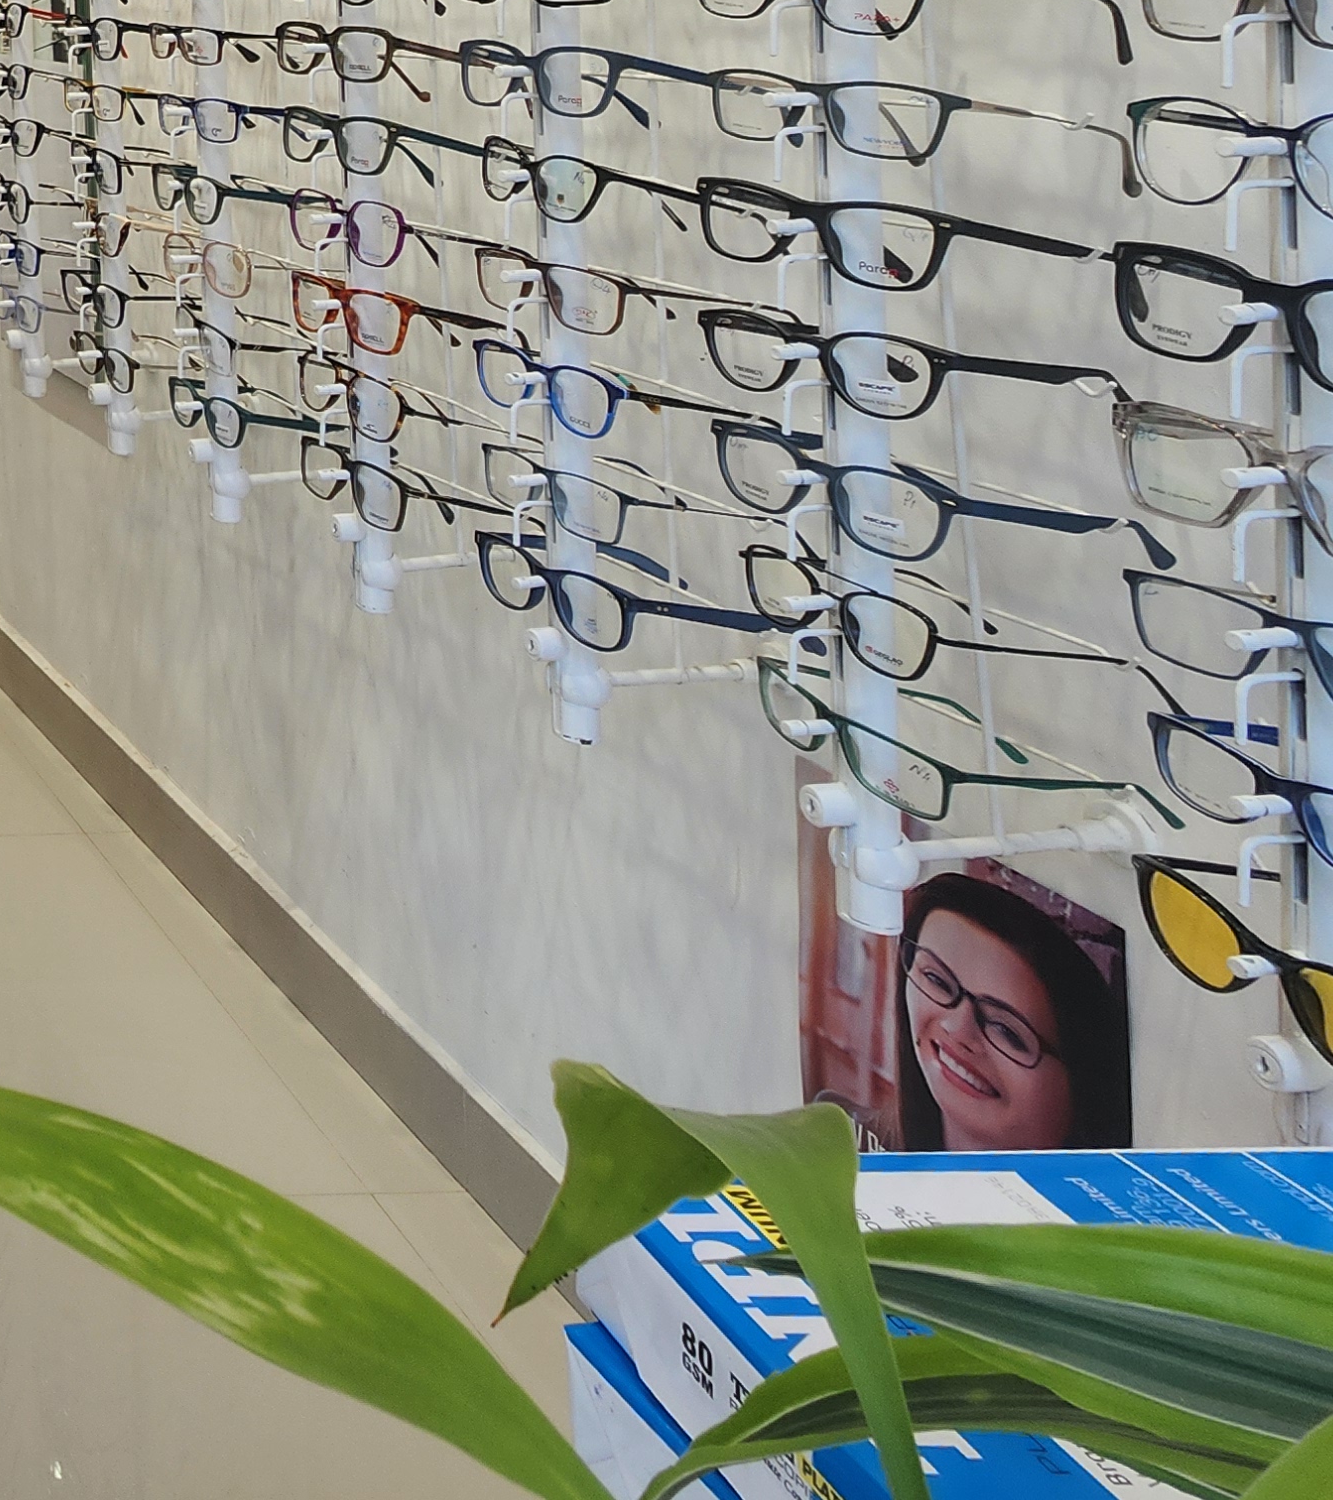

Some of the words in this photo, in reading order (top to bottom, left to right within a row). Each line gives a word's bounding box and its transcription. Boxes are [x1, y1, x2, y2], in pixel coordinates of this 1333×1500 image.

[1152, 323, 1192, 339] PRODIGY
[733, 364, 763, 377] PRODIGY
[681, 1321, 714, 1378] 80
[681, 1351, 714, 1400] GSM
